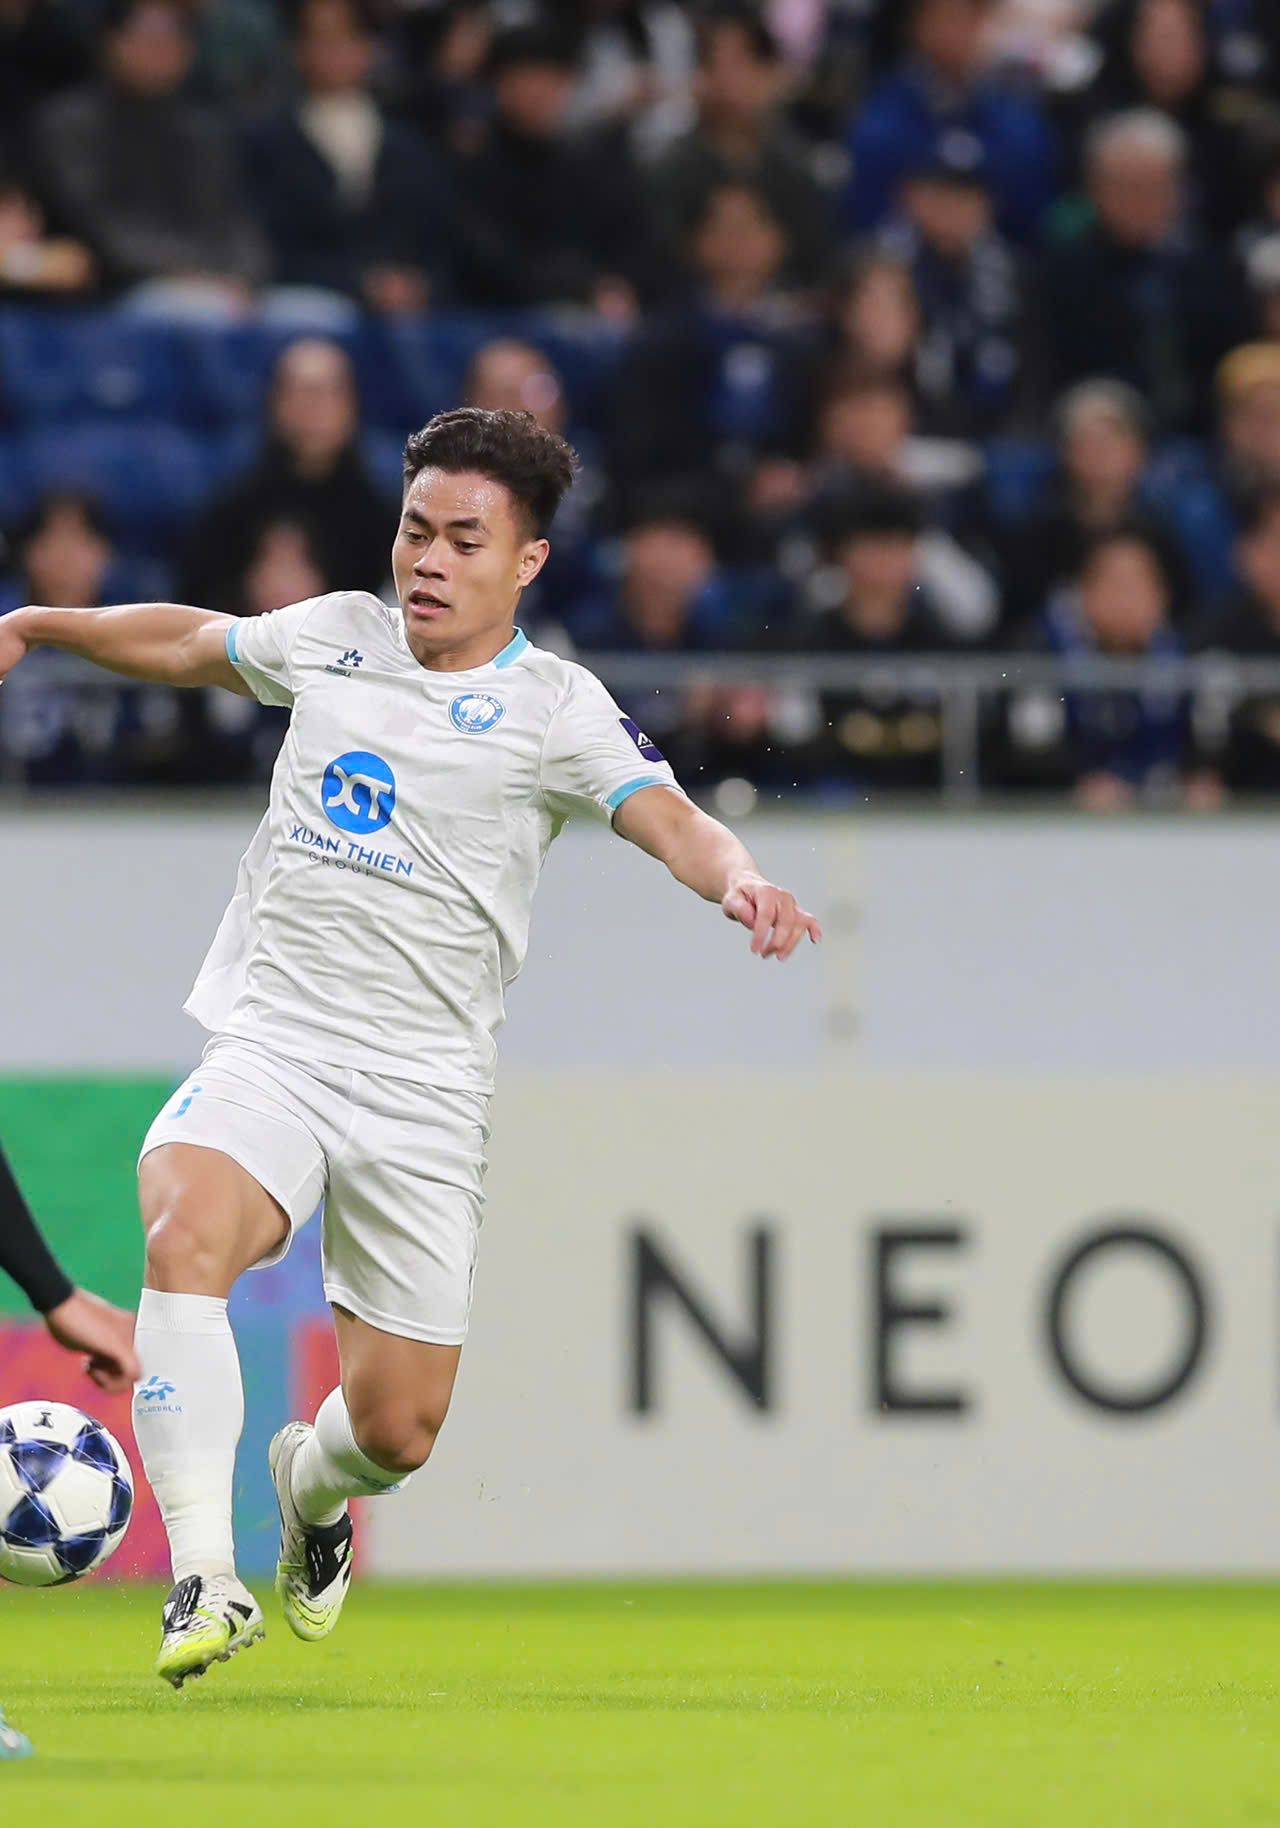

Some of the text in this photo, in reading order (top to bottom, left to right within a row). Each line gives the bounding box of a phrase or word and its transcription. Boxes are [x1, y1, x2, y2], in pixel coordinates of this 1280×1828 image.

[289, 823, 414, 877] XUAN THIEN
[308, 850, 375, 878] GROUP
[628, 1217, 1280, 1418] NEO
